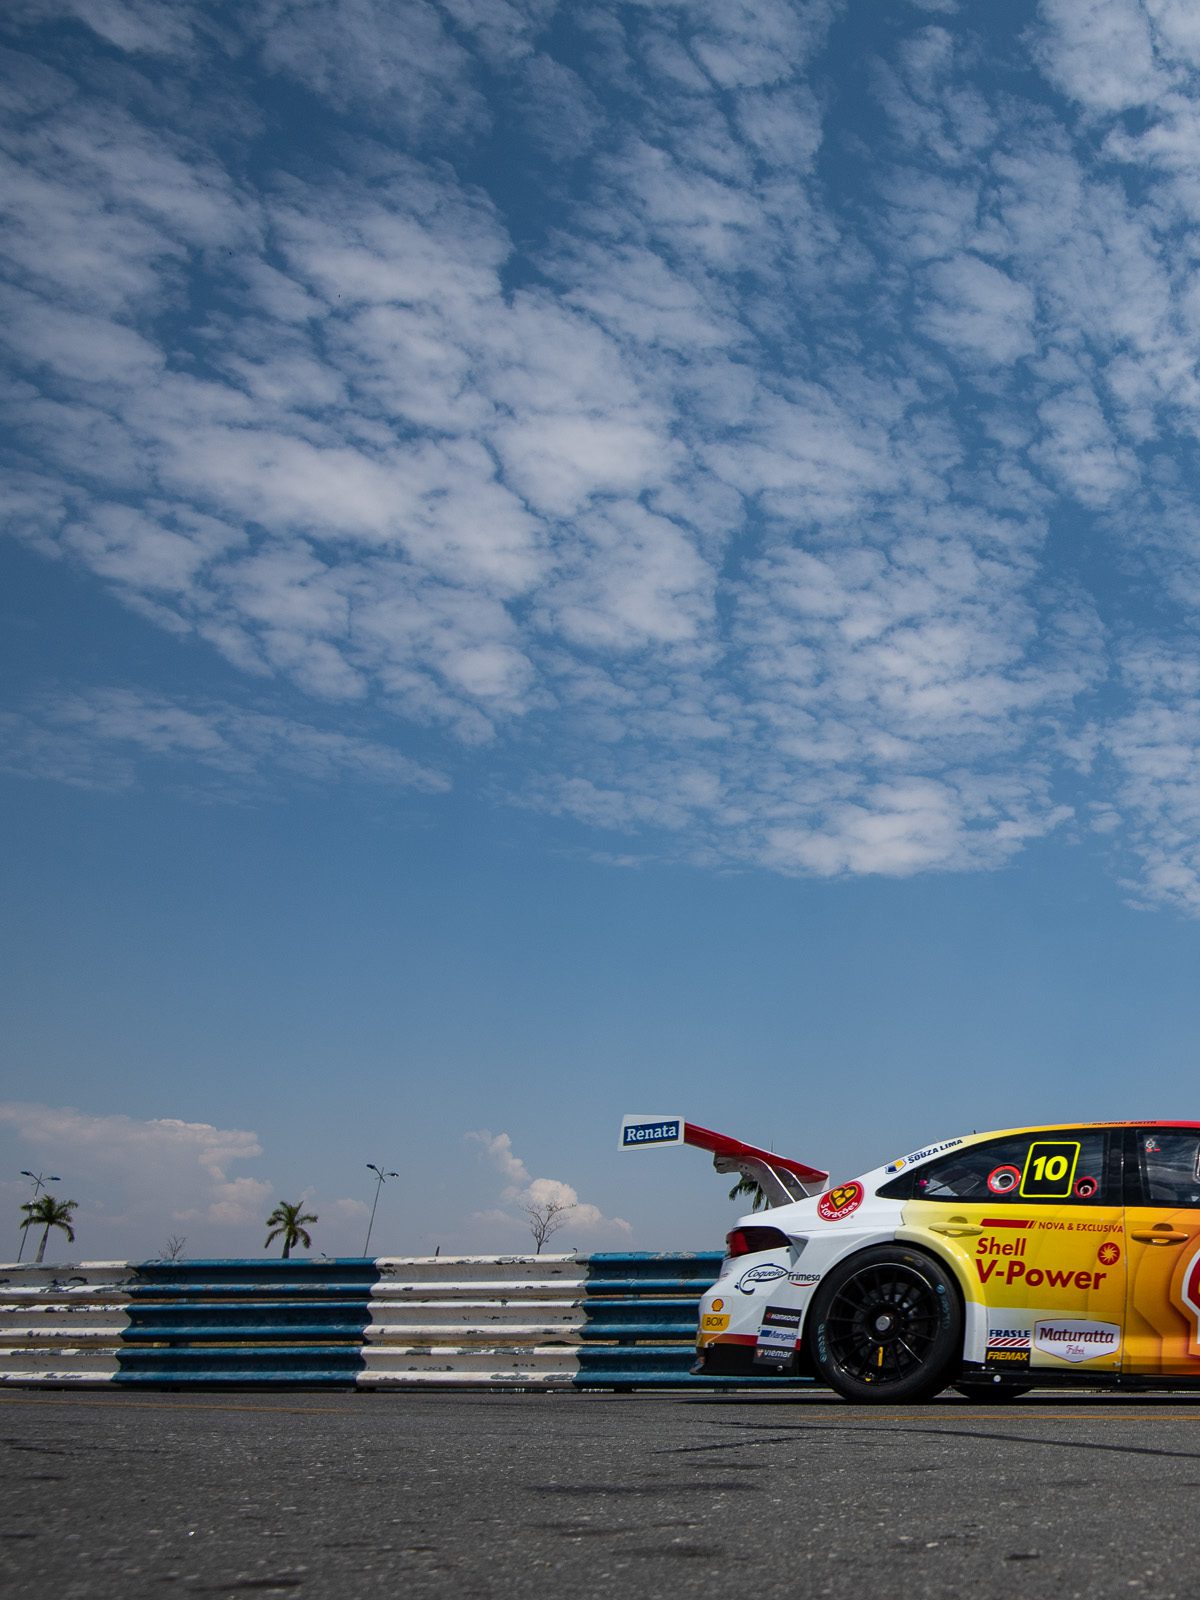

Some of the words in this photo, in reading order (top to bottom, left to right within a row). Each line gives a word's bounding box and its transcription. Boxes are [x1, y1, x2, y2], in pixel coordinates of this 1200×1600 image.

[626, 1125, 677, 1141] Renata
[908, 1148, 939, 1164] SOUZA
[940, 1139, 964, 1151] LIMA
[1033, 1156, 1068, 1181] 10
[1038, 1221, 1065, 1231] NOVA
[1067, 1222, 1074, 1231] &
[1076, 1223, 1124, 1233] EXCLUSIVA
[976, 1236, 1027, 1256] Shell
[787, 1271, 821, 1281] Frimesa
[975, 1258, 1107, 1290] V-Power
[706, 1317, 724, 1327] BOX
[1039, 1327, 1115, 1343] Maturatta
[987, 1351, 1029, 1361] FREMAX
